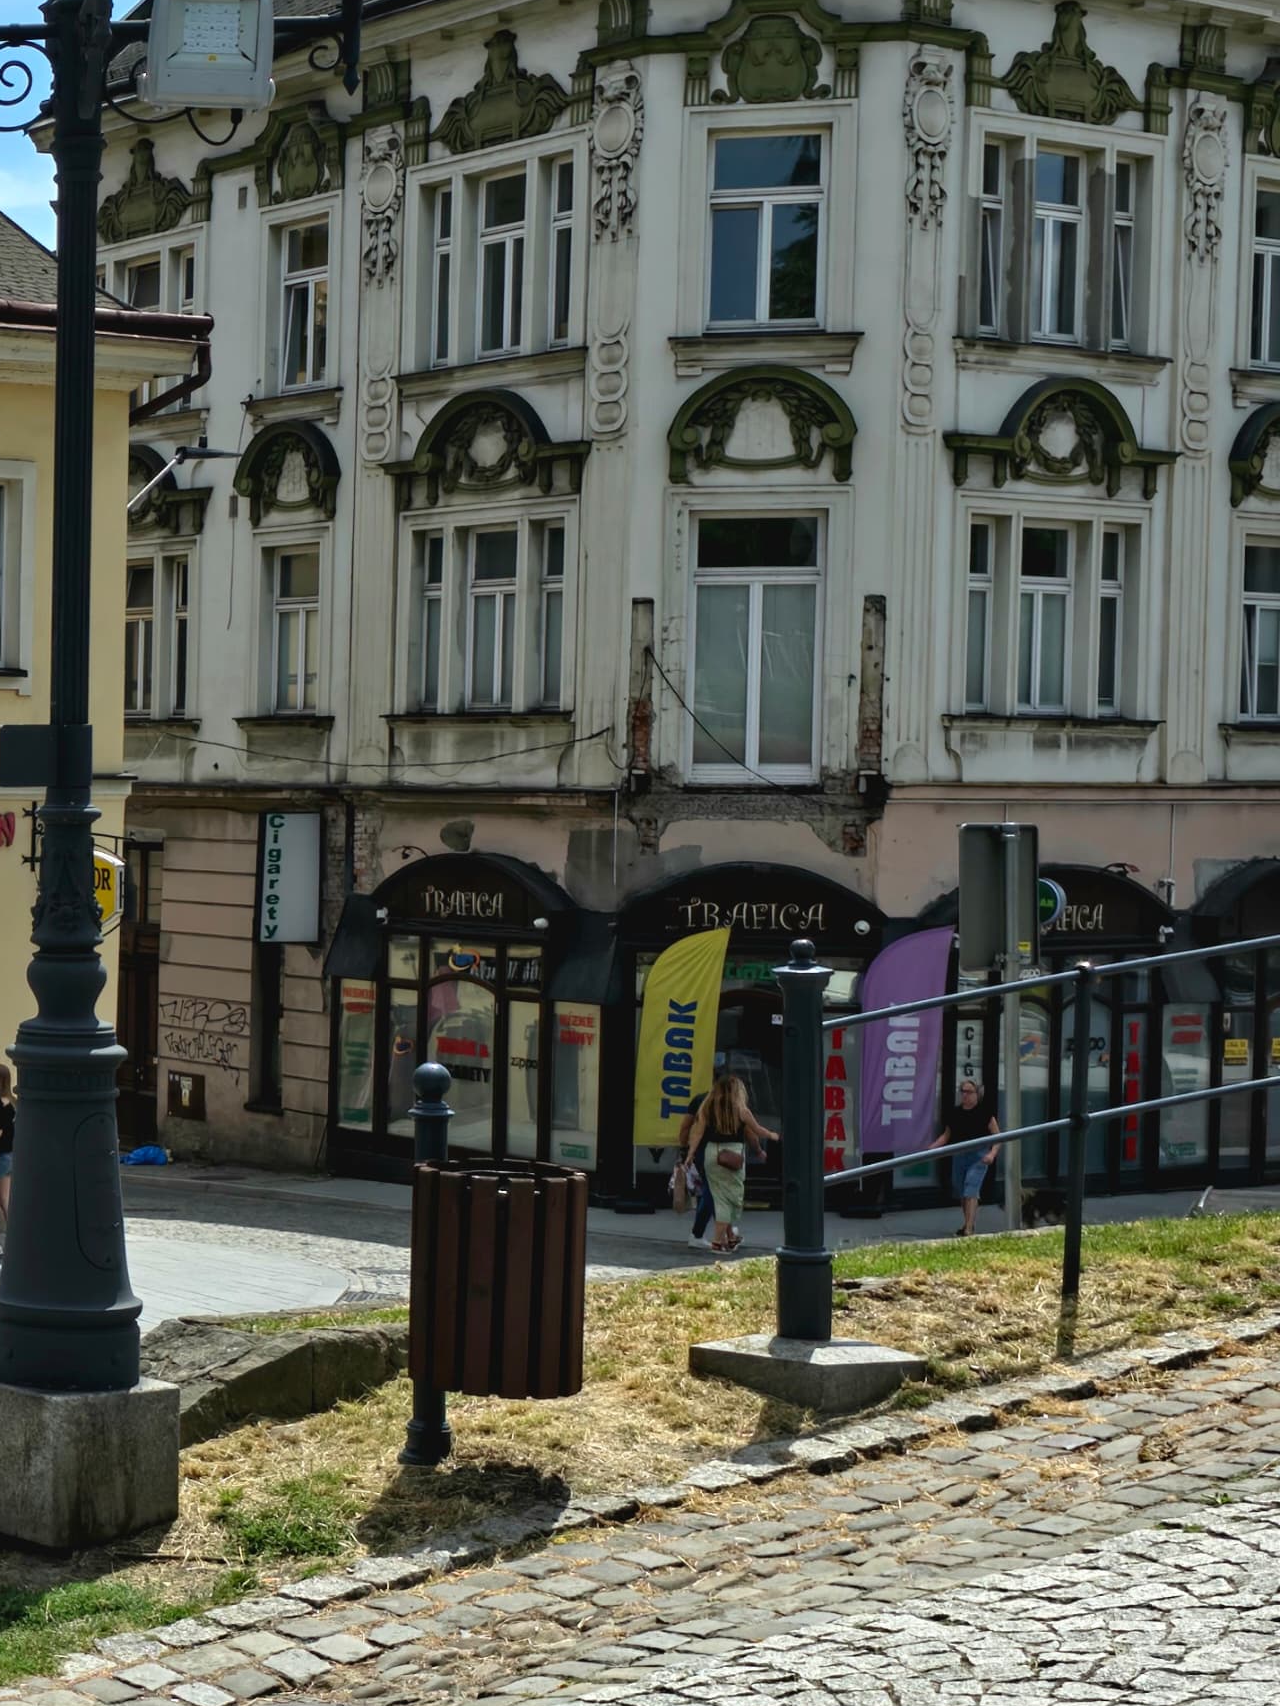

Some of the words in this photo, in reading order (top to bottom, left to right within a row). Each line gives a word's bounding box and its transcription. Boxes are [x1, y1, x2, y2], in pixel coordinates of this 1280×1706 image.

[264, 814, 285, 939] Cigarety
[423, 886, 503, 918] TRAFICA
[679, 897, 827, 931] TRAFICA
[660, 998, 698, 1119] TABAK
